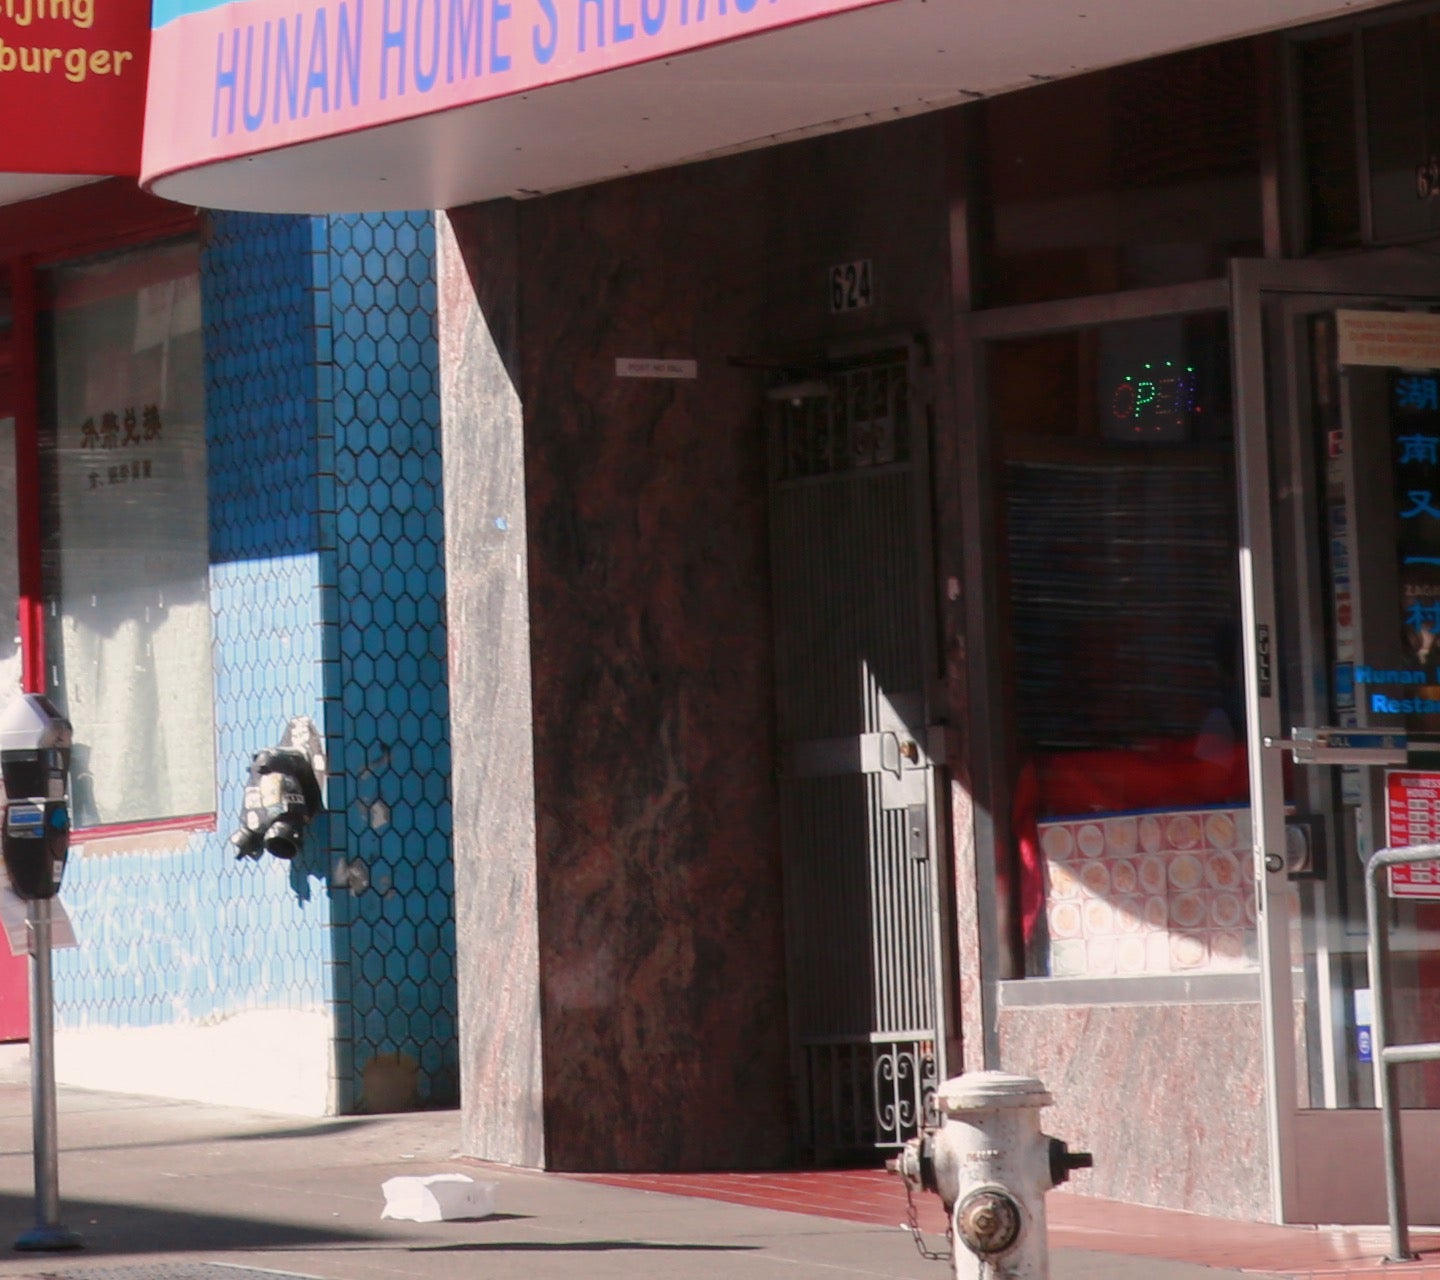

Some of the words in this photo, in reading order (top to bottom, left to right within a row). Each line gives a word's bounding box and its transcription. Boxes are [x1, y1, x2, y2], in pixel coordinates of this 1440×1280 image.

[831, 260, 872, 312] 624
[1112, 374, 1197, 420] OPEN
[1355, 665, 1426, 685] Hunan
